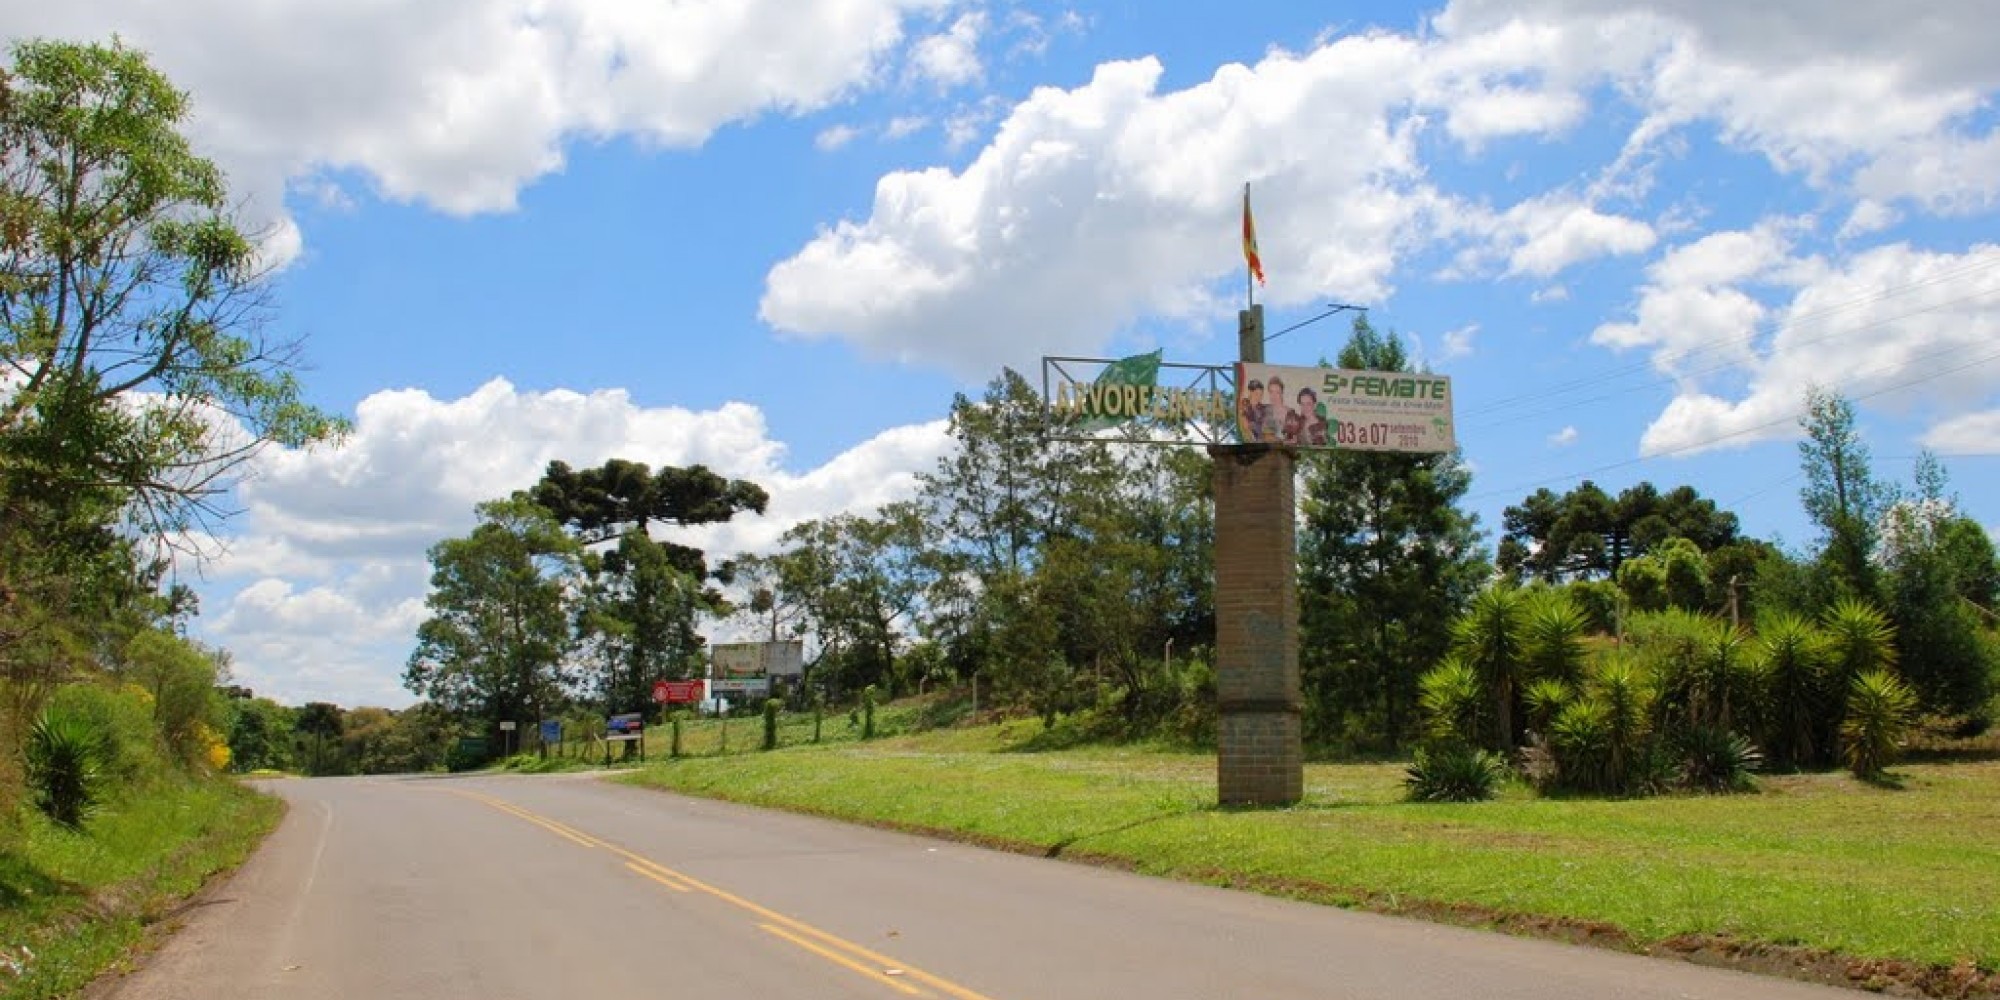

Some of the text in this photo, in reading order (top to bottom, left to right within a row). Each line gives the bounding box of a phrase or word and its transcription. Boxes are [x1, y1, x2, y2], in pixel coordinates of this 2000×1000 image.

[1055, 382, 1227, 420] ARVOREZINHA
[1338, 421, 1356, 444] 03
[1359, 427, 1368, 444] a
[1371, 423, 1388, 446] 07
